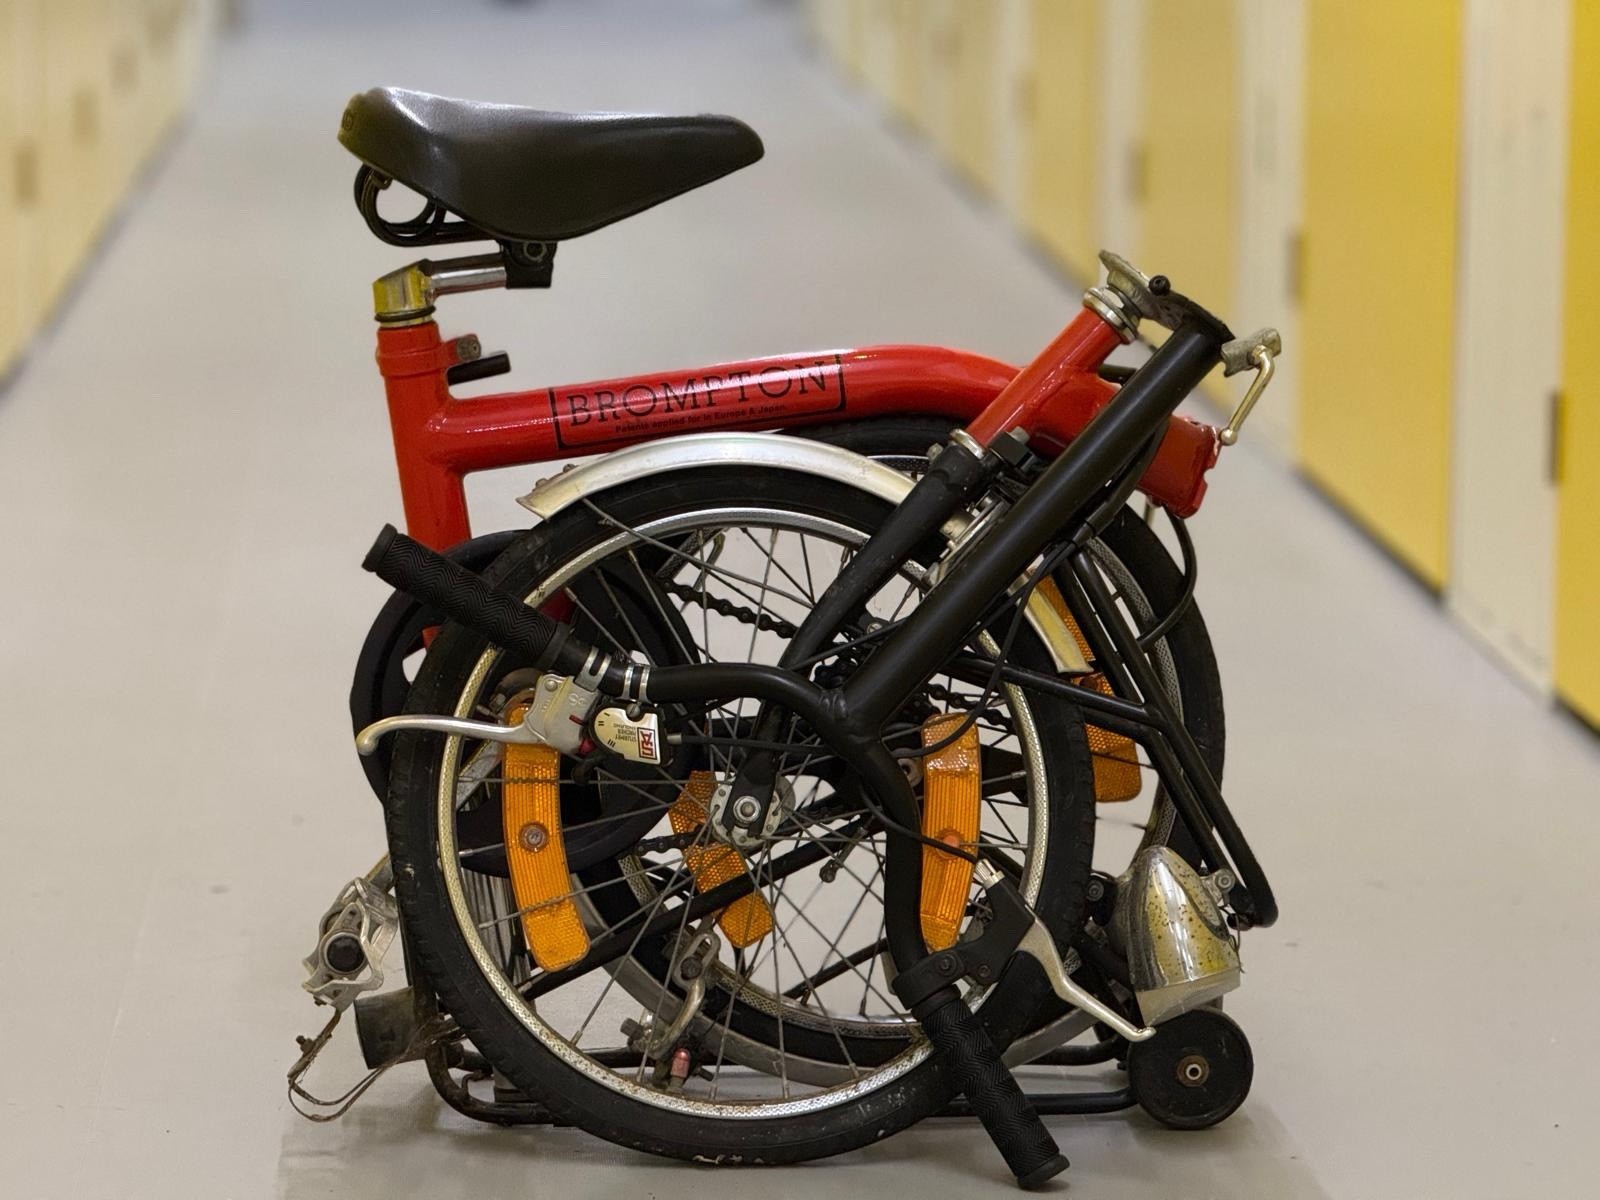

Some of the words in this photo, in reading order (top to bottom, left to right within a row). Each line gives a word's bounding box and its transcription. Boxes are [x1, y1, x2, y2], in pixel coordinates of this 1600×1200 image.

[566, 360, 826, 427] BROMPTON
[615, 420, 649, 433] Patents
[652, 415, 685, 430] applied
[715, 408, 746, 420] Europe
